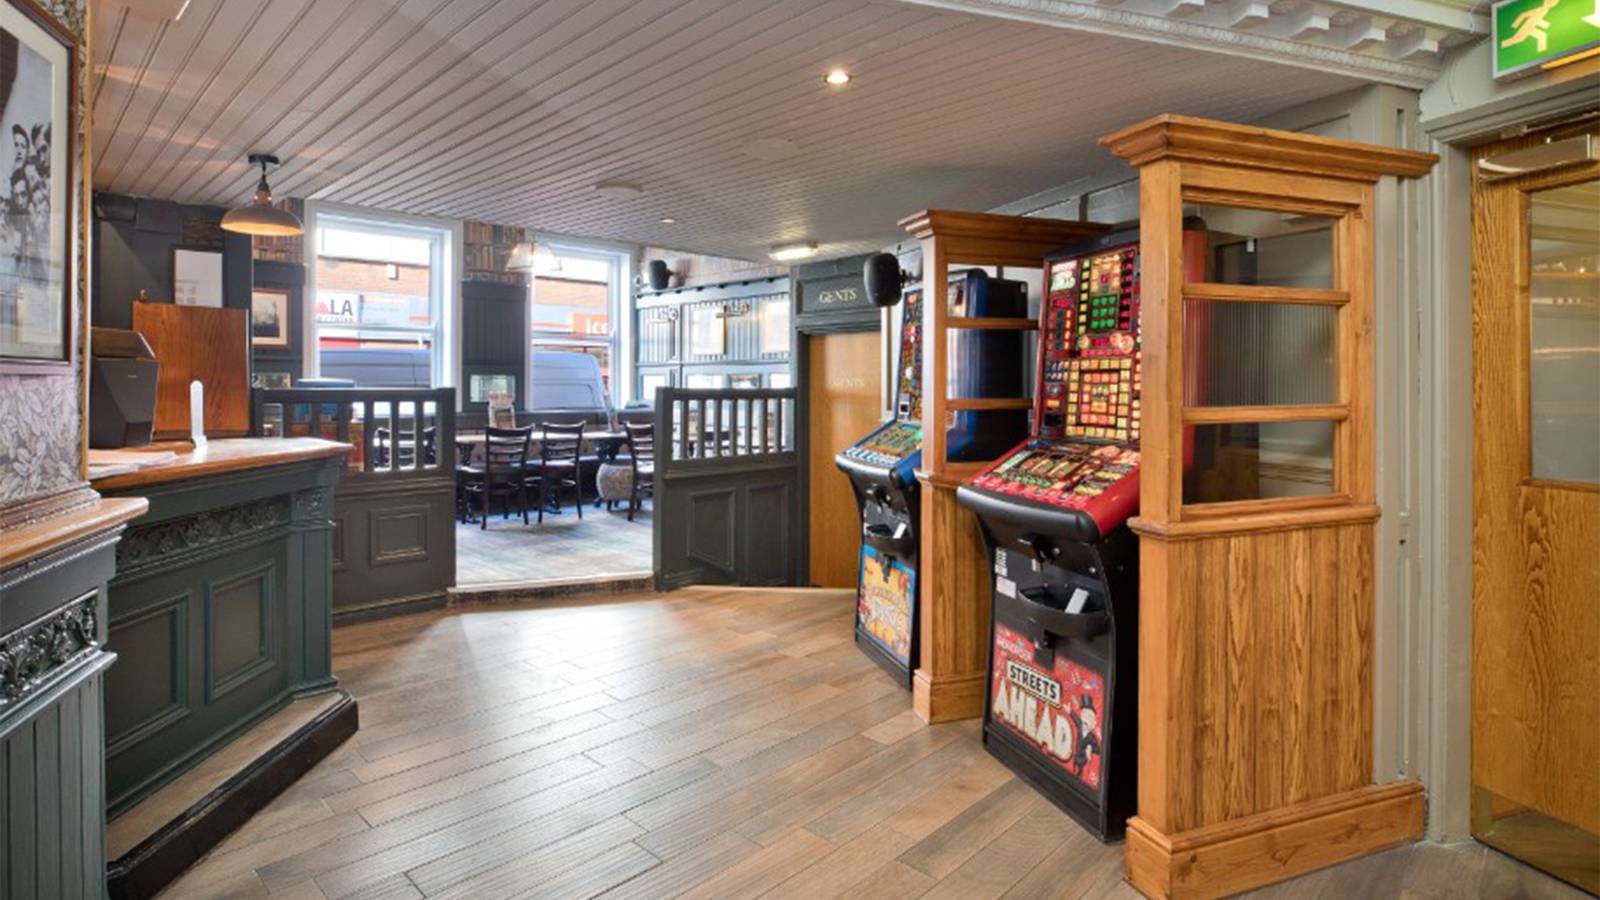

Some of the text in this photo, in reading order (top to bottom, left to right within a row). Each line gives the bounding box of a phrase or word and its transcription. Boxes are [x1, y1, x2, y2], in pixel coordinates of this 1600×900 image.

[819, 288, 857, 303] GENTS
[1009, 664, 1057, 699] STREETS
[993, 679, 1073, 762] AHEAD
